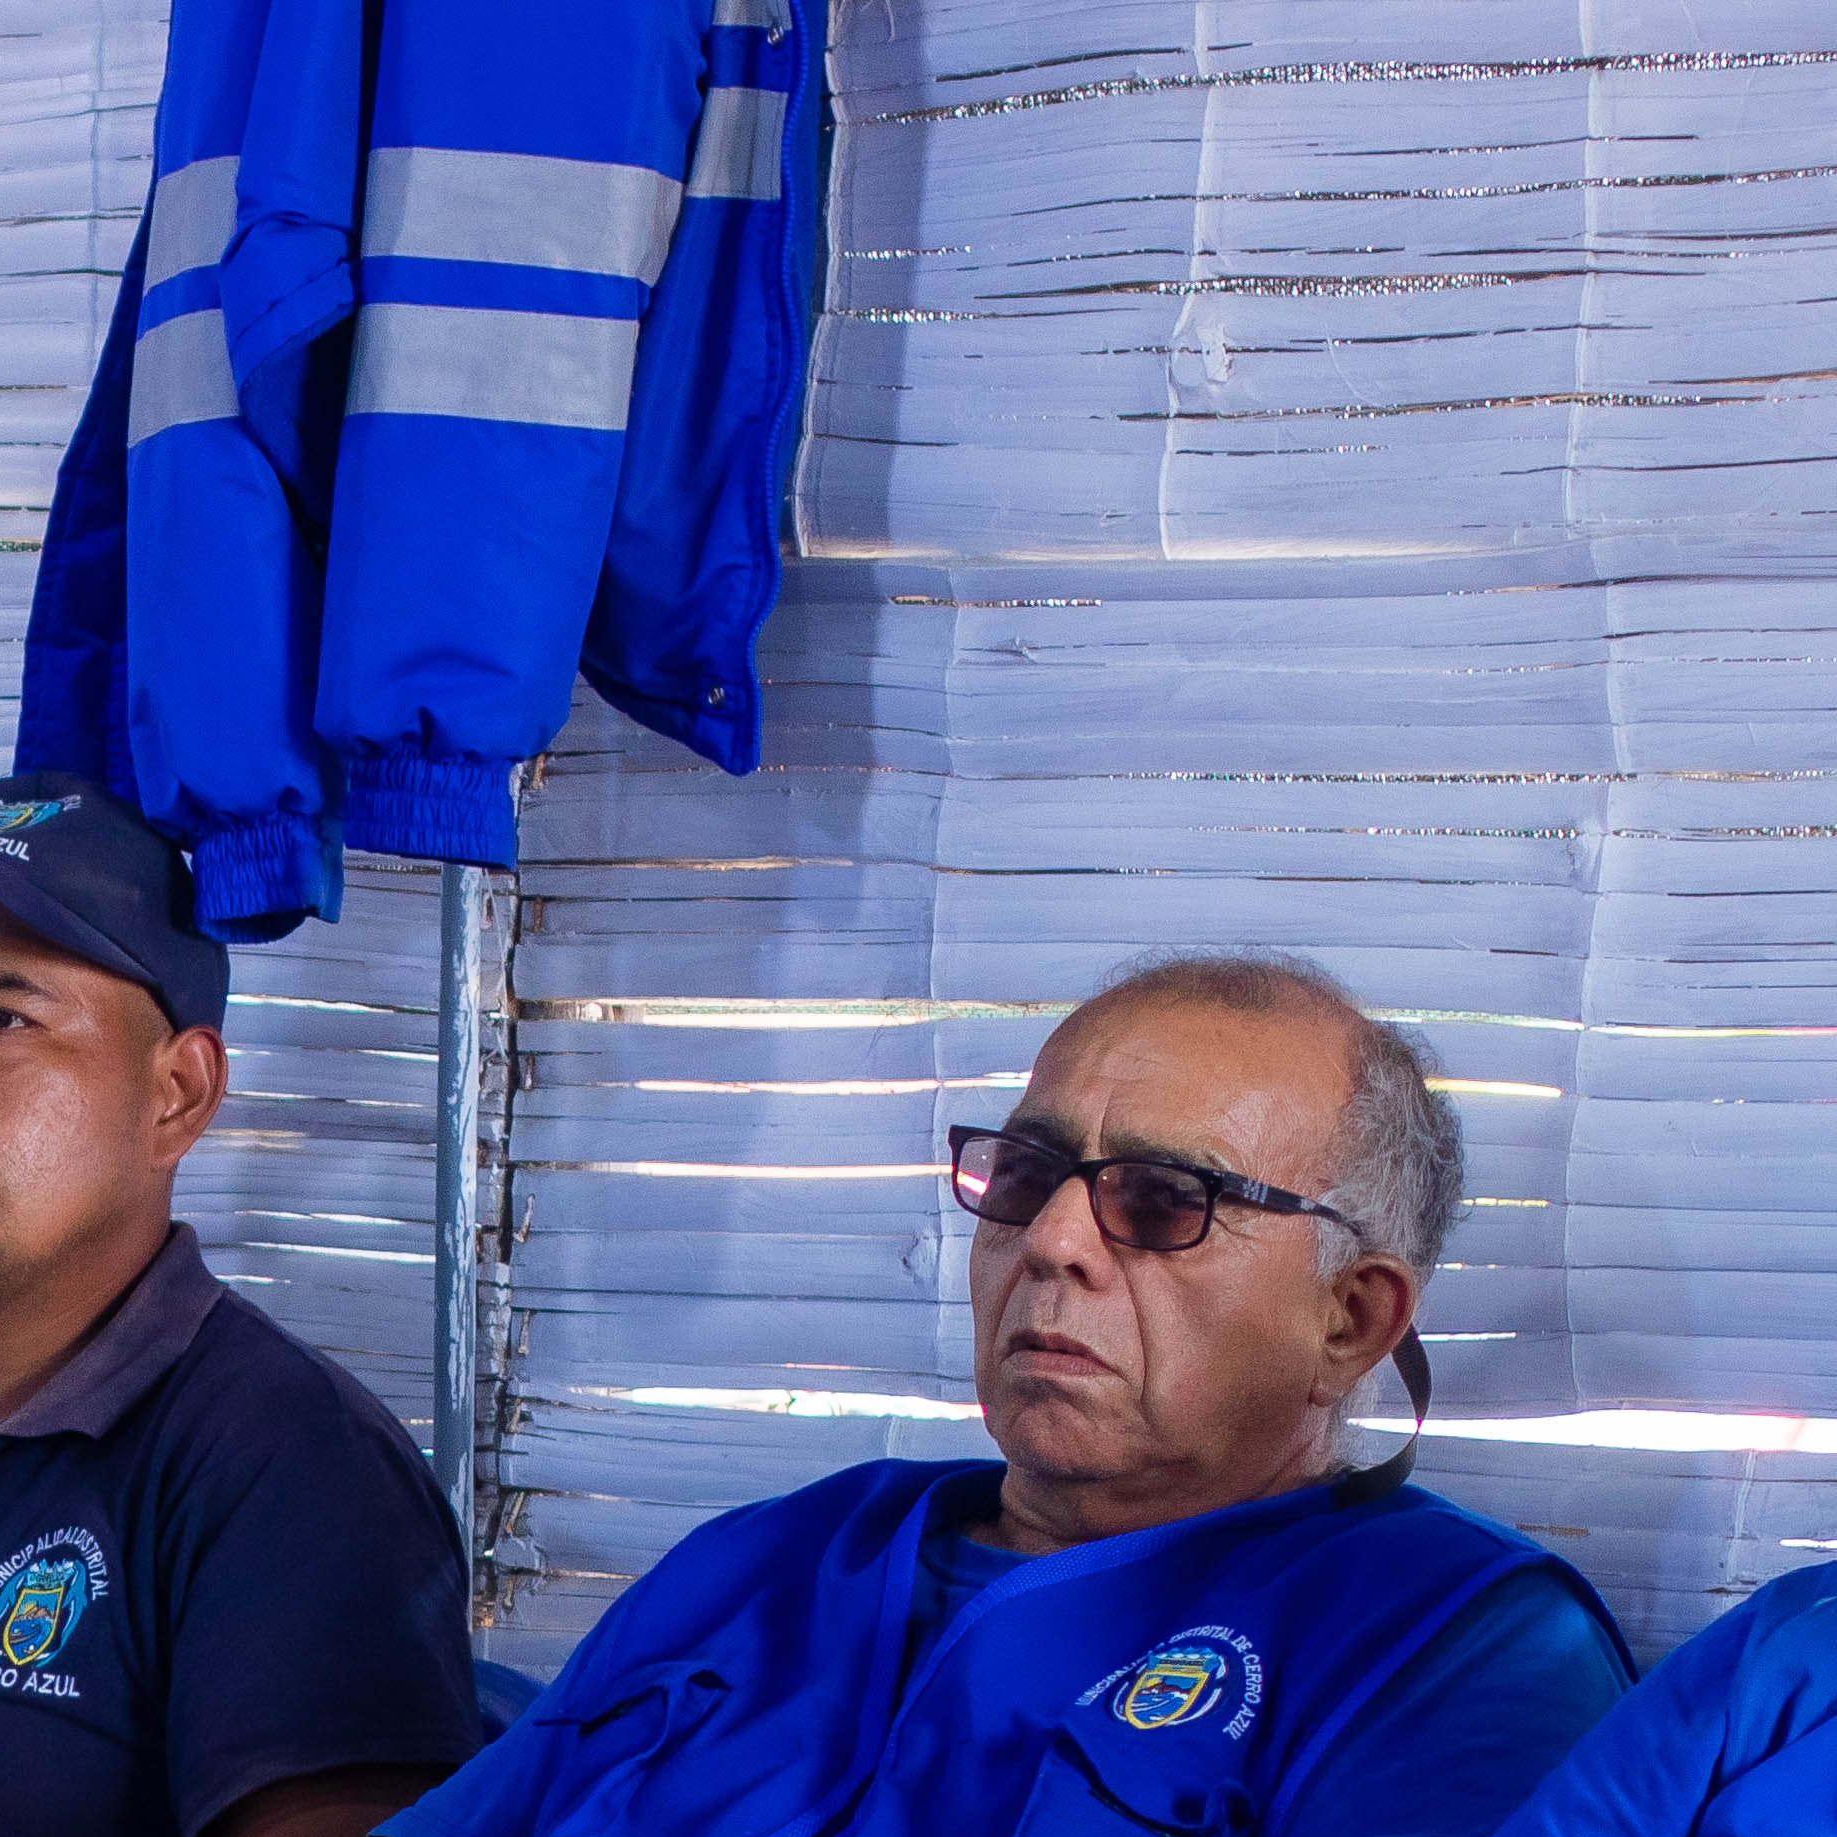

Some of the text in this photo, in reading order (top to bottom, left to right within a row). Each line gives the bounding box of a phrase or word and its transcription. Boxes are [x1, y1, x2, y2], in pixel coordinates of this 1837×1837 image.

[1168, 1625, 1235, 1644] DISTRITAL
[1232, 1635, 1254, 1654] DE
[22, 1671, 81, 1697] AZUL
[1242, 1654, 1263, 1705] CERRO
[1222, 1703, 1256, 1740] AZUL
